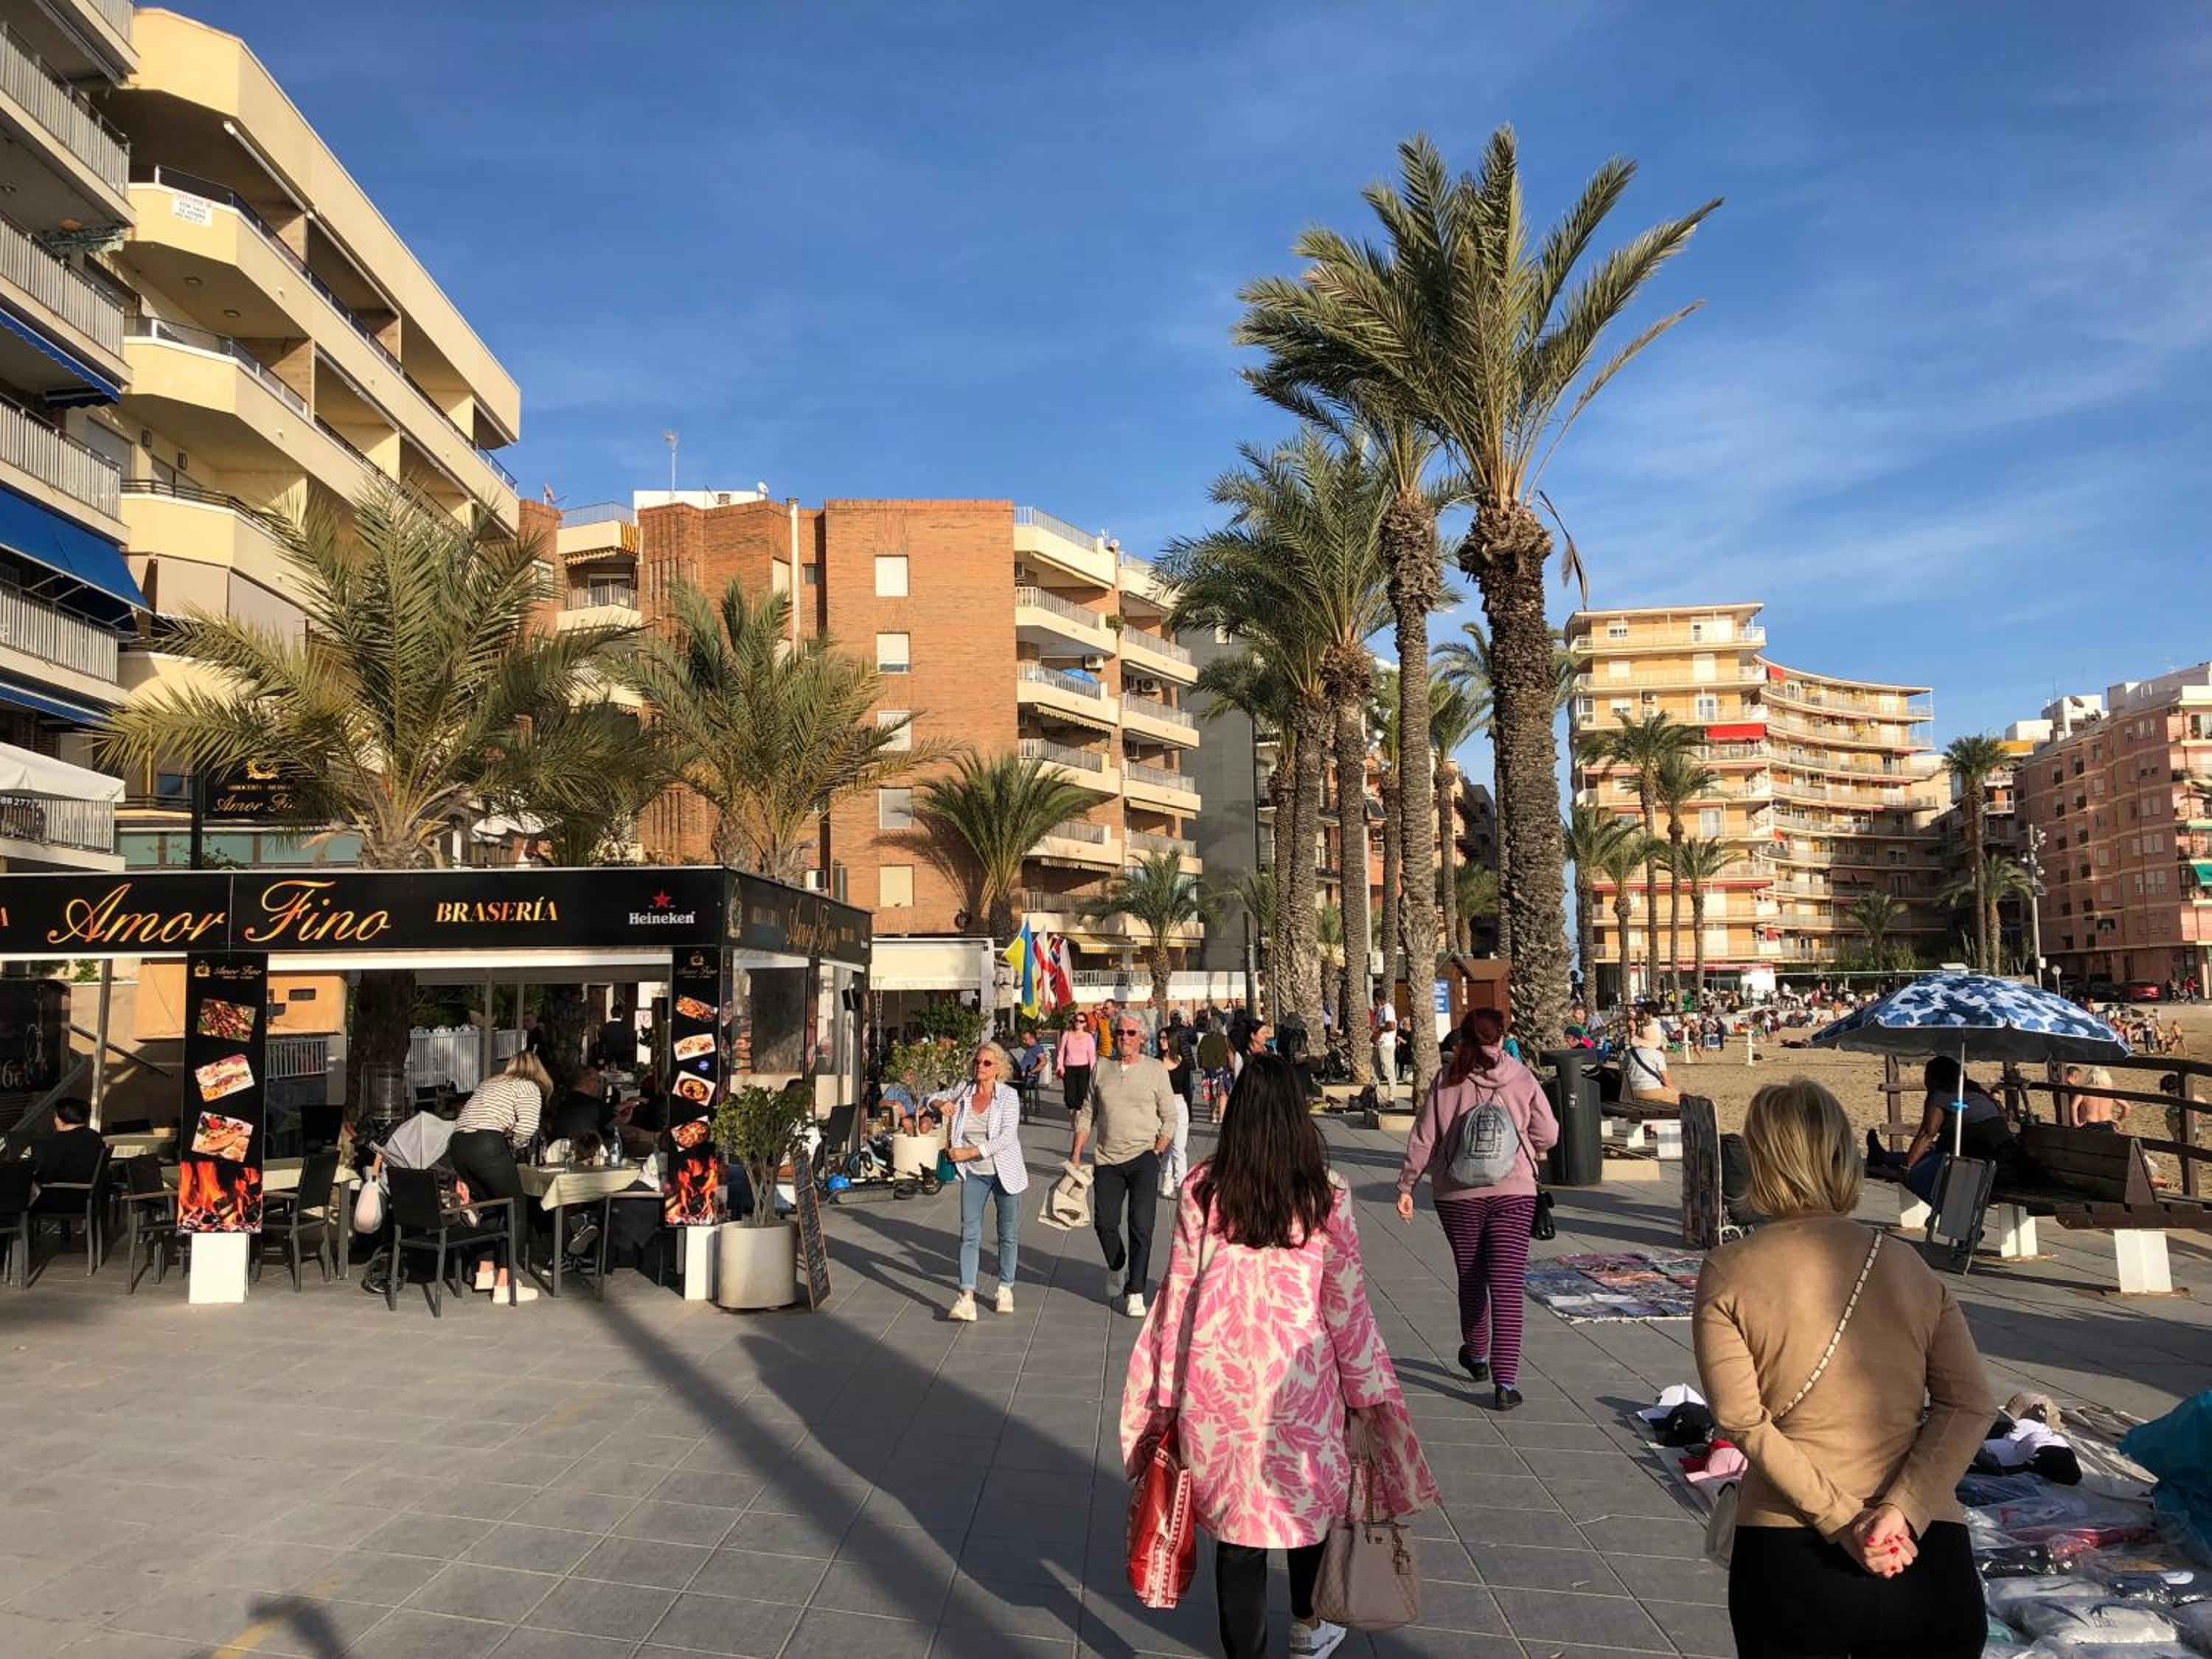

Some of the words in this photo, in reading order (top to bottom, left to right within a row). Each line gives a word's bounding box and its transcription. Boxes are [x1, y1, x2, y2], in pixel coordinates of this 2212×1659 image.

[213, 793, 263, 811] Amor
[268, 793, 296, 812] Fi
[47, 883, 226, 943] Amor
[244, 880, 391, 942] Fino
[435, 896, 558, 922] BRASERÍA
[628, 911, 696, 925] Heineken
